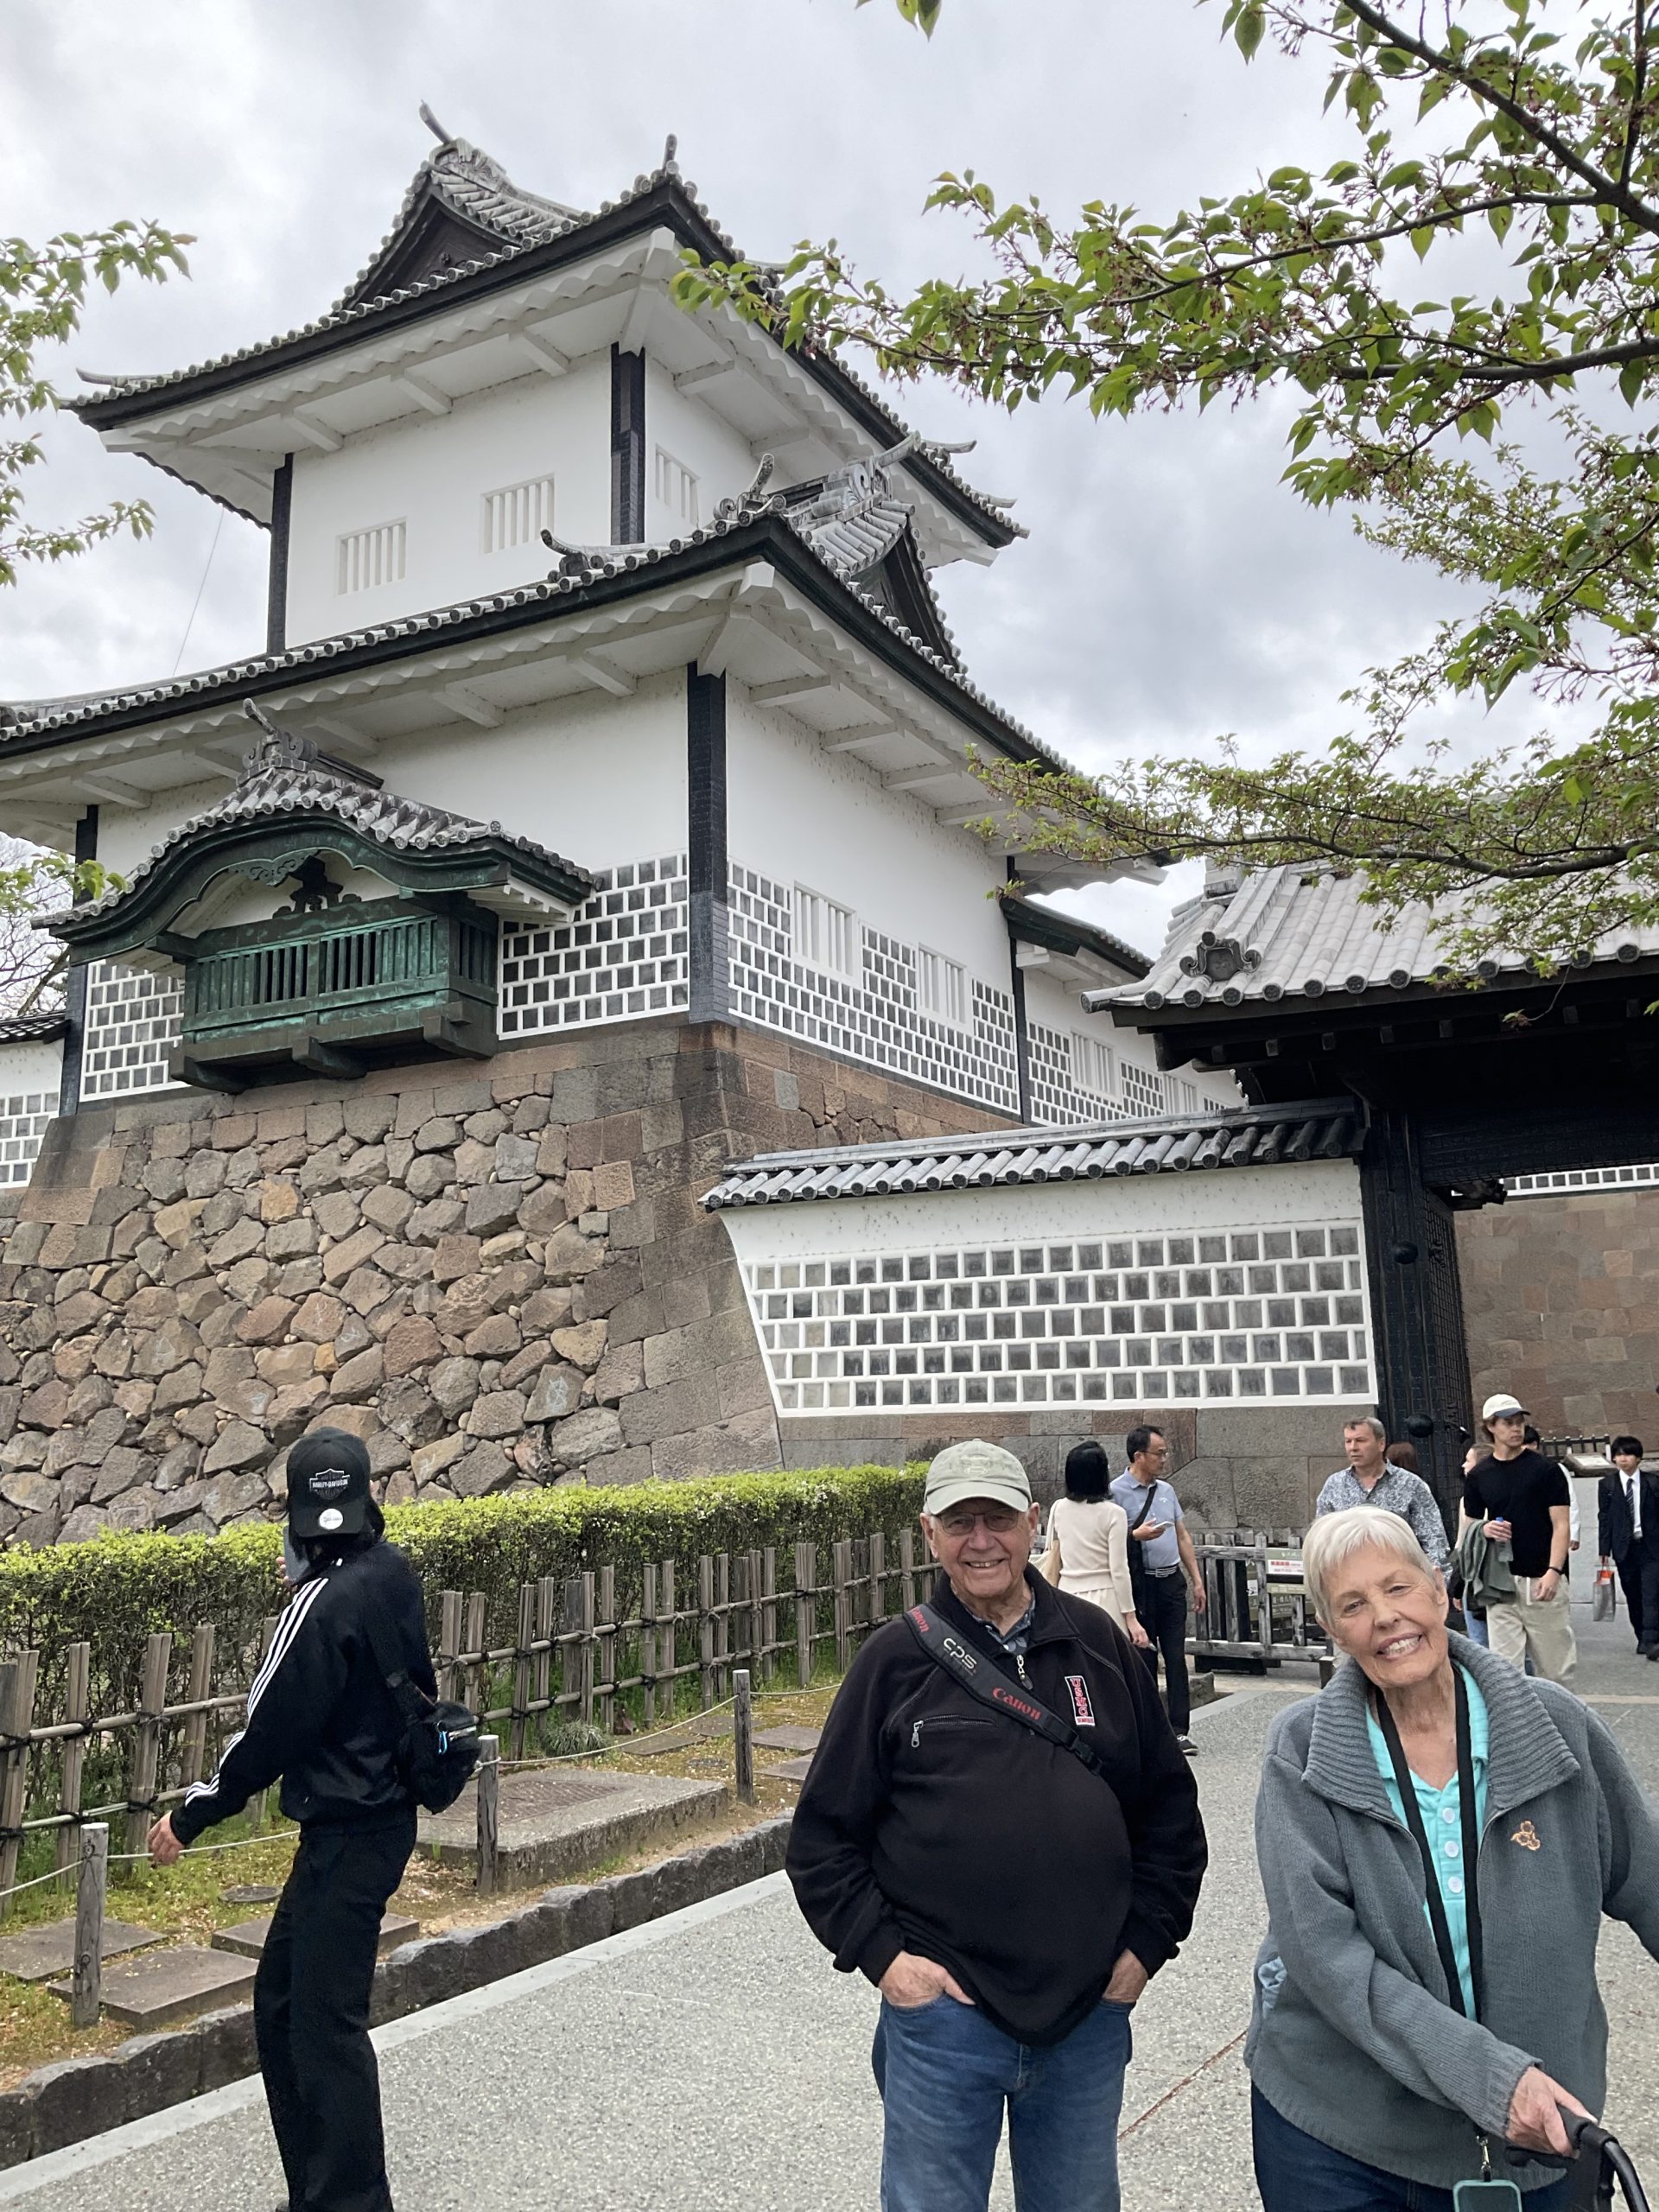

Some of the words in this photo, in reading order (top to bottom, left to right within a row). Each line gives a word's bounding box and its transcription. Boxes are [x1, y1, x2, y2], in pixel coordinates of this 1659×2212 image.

[912, 1608, 930, 1632] anon
[944, 1637, 977, 1669] CPS
[993, 1687, 1041, 1720] Canon
